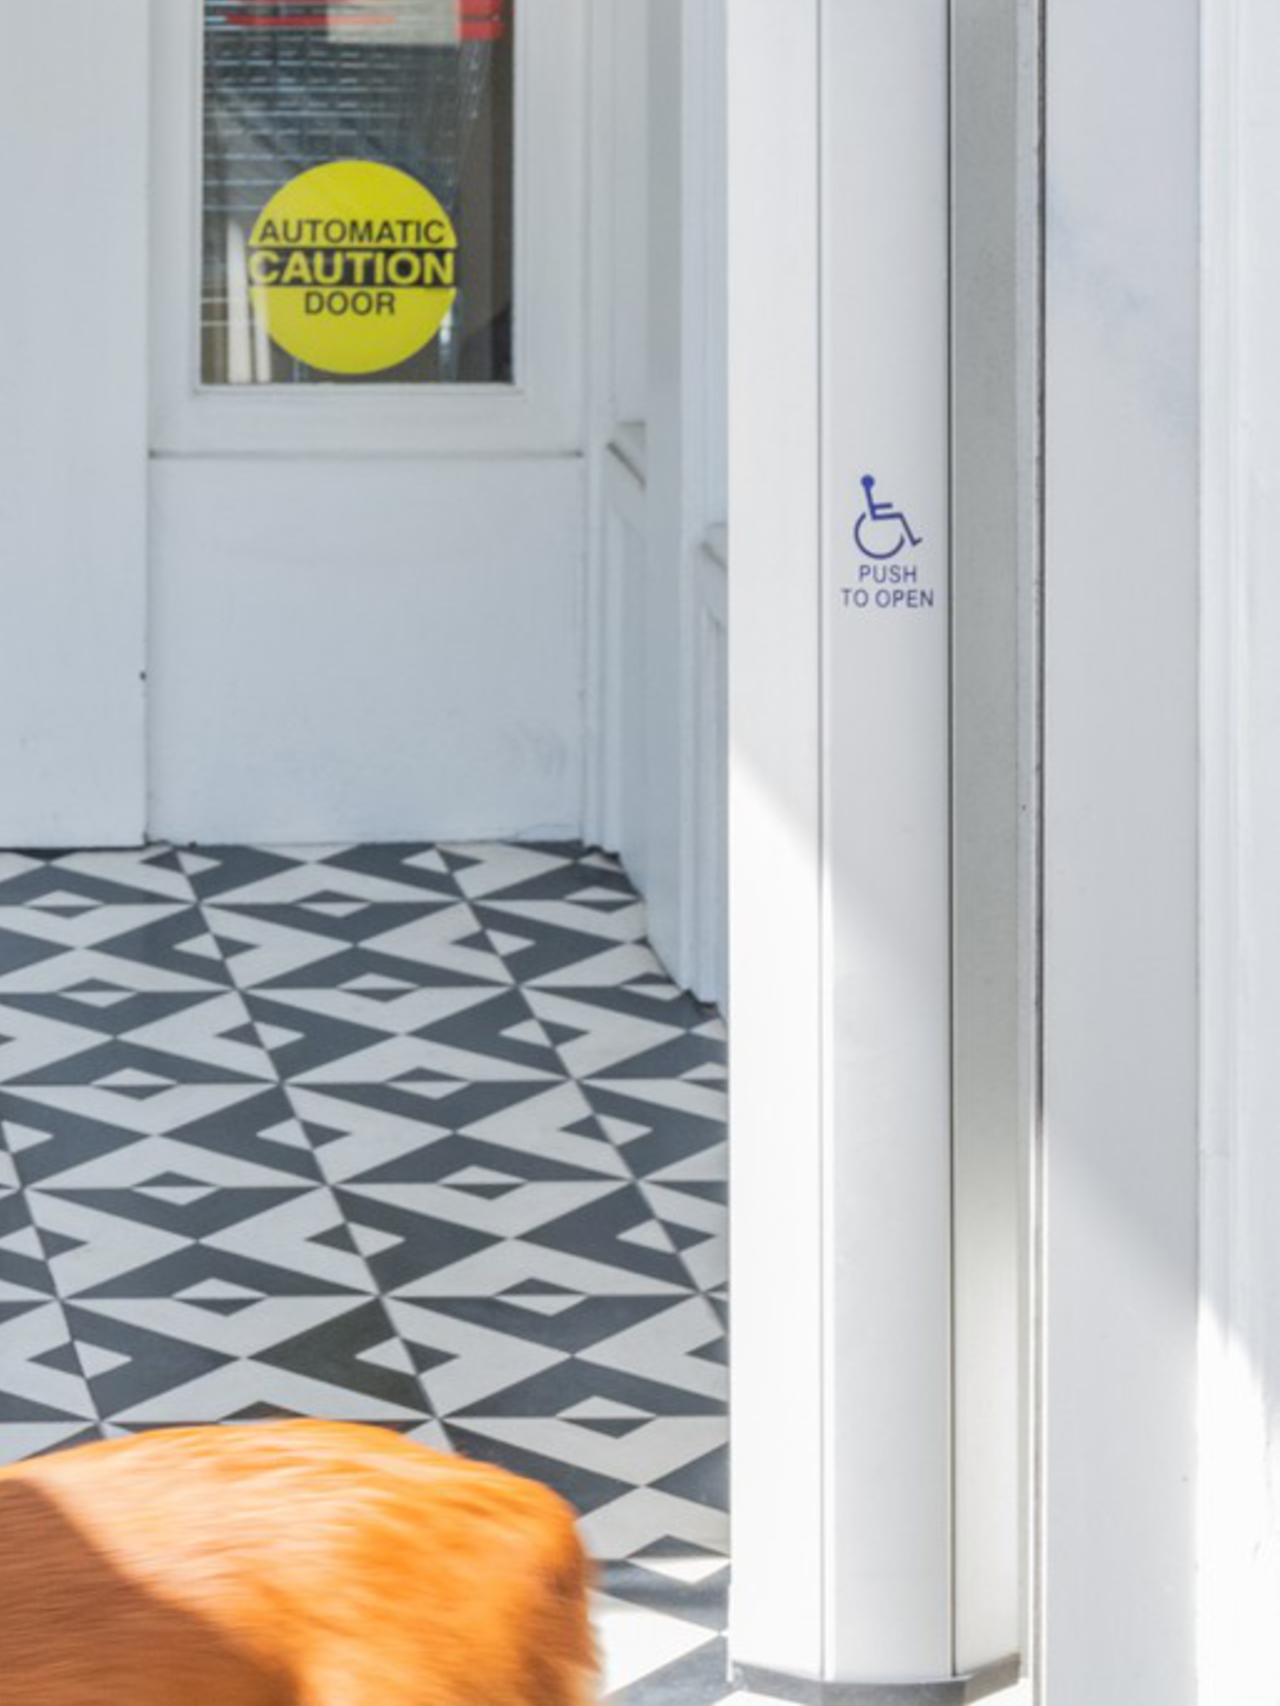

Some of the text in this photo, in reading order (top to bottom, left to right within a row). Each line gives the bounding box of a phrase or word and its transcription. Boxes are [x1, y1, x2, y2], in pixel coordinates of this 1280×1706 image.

[260, 220, 445, 244] AUTOMATIC
[248, 250, 454, 285] CAUTION
[303, 291, 396, 316] DOOR
[858, 565, 917, 584] PUSH
[841, 589, 935, 608] TO OPEN
